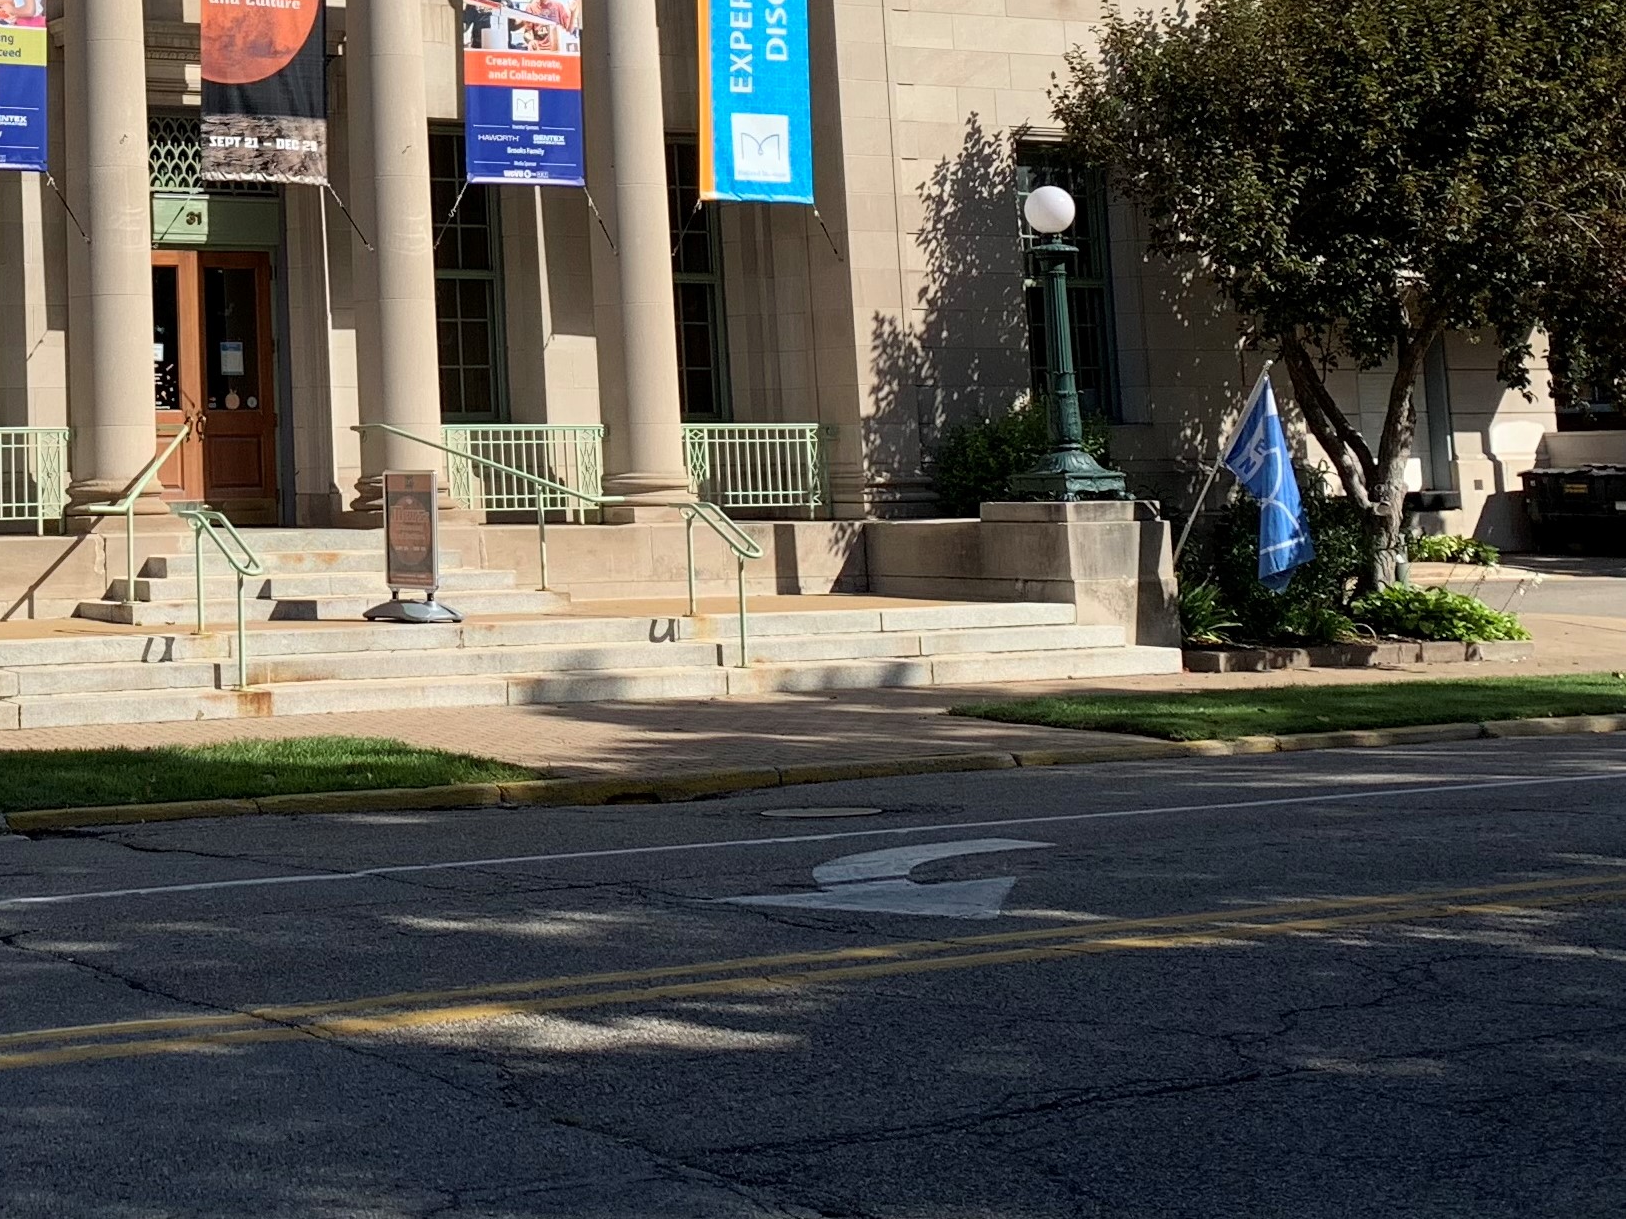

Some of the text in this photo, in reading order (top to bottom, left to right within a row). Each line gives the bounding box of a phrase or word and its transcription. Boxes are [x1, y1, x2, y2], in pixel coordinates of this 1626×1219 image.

[488, 69, 562, 82] and Collaborate
[208, 135, 242, 148] SEPT
[244, 137, 260, 149] 21
[275, 137, 300, 151] DEC
[186, 211, 202, 225] 31
